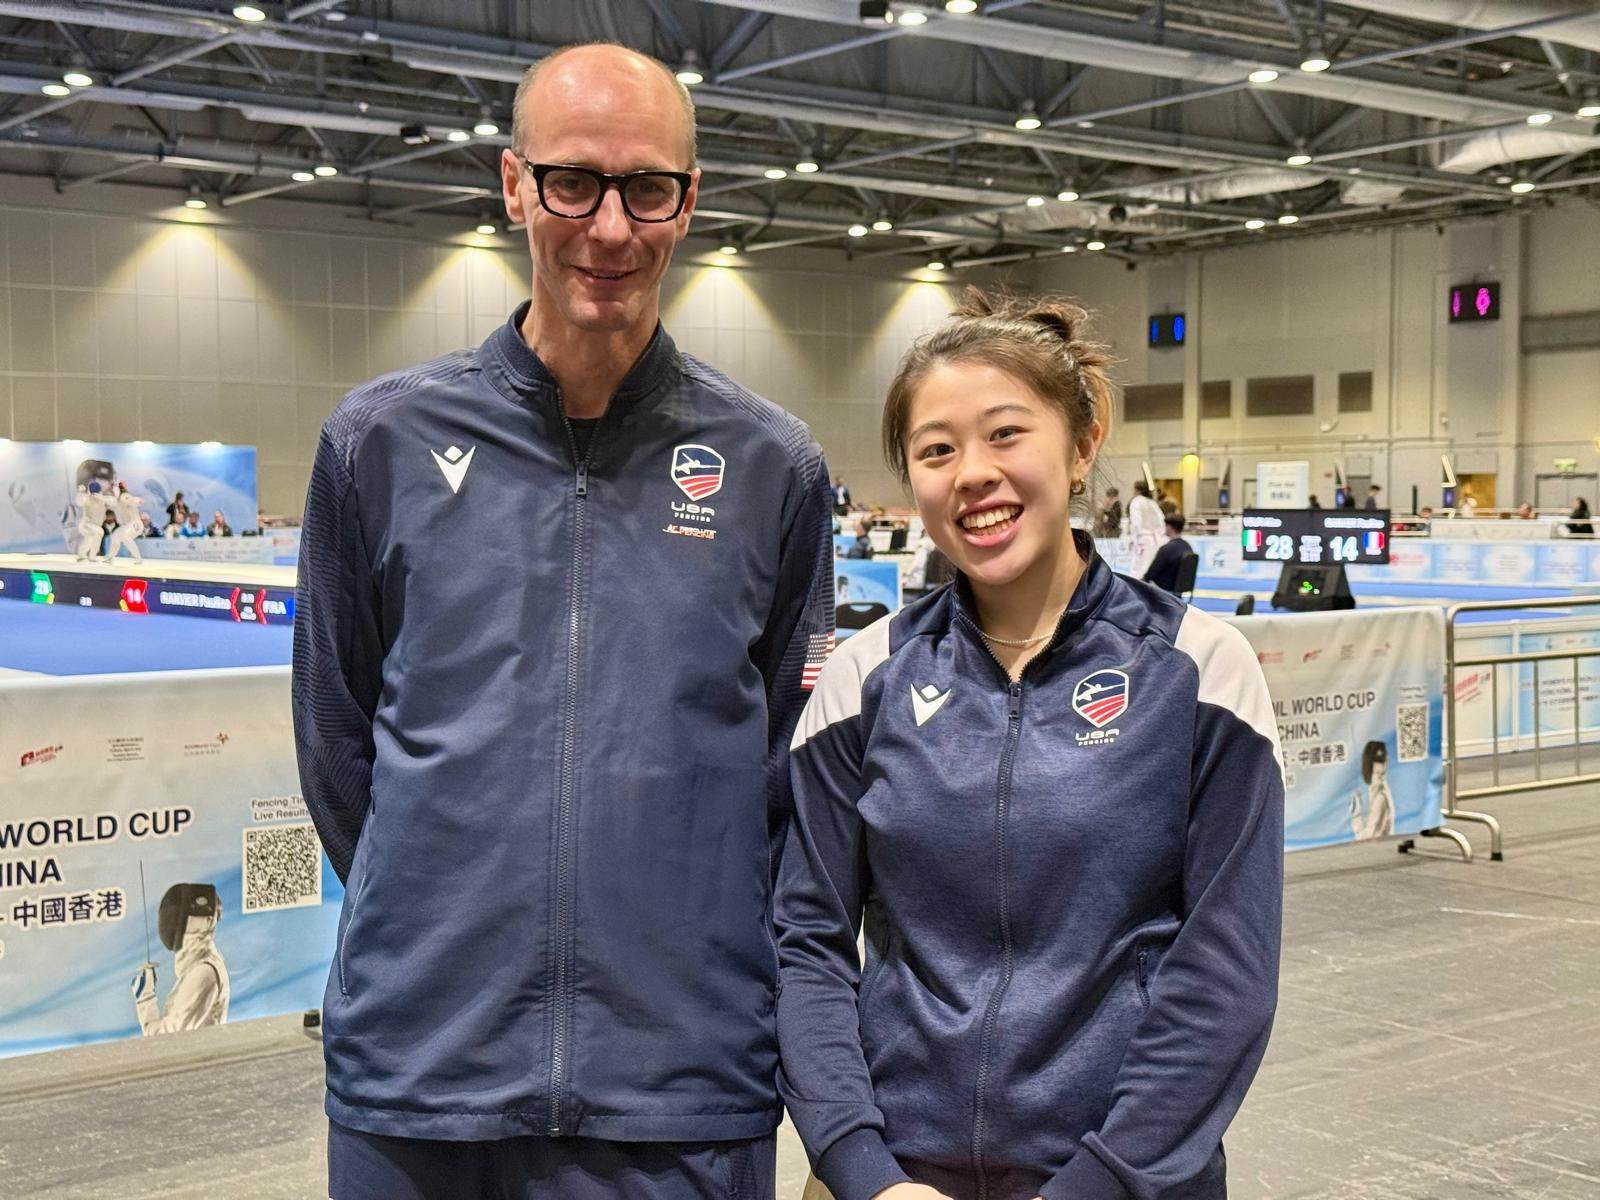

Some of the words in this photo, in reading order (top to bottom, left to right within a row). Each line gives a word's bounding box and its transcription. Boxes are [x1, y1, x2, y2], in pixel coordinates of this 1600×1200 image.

[671, 501, 715, 516] USA
[674, 512, 711, 522] FENCING
[1265, 534, 1293, 560] 28
[1330, 536, 1359, 561] 14
[262, 600, 287, 614] FRA
[1292, 695, 1343, 716] WORLD
[1347, 691, 1375, 709] CUP
[1075, 728, 1119, 741] USA
[1279, 722, 1319, 741] CHINA
[1300, 744, 1345, 766] 中國香港
[251, 797, 288, 808] Fencing
[254, 811, 273, 820] Live
[0, 815, 118, 848] WORLD
[129, 809, 191, 837] CUP
[13, 890, 123, 927] 中國香港
